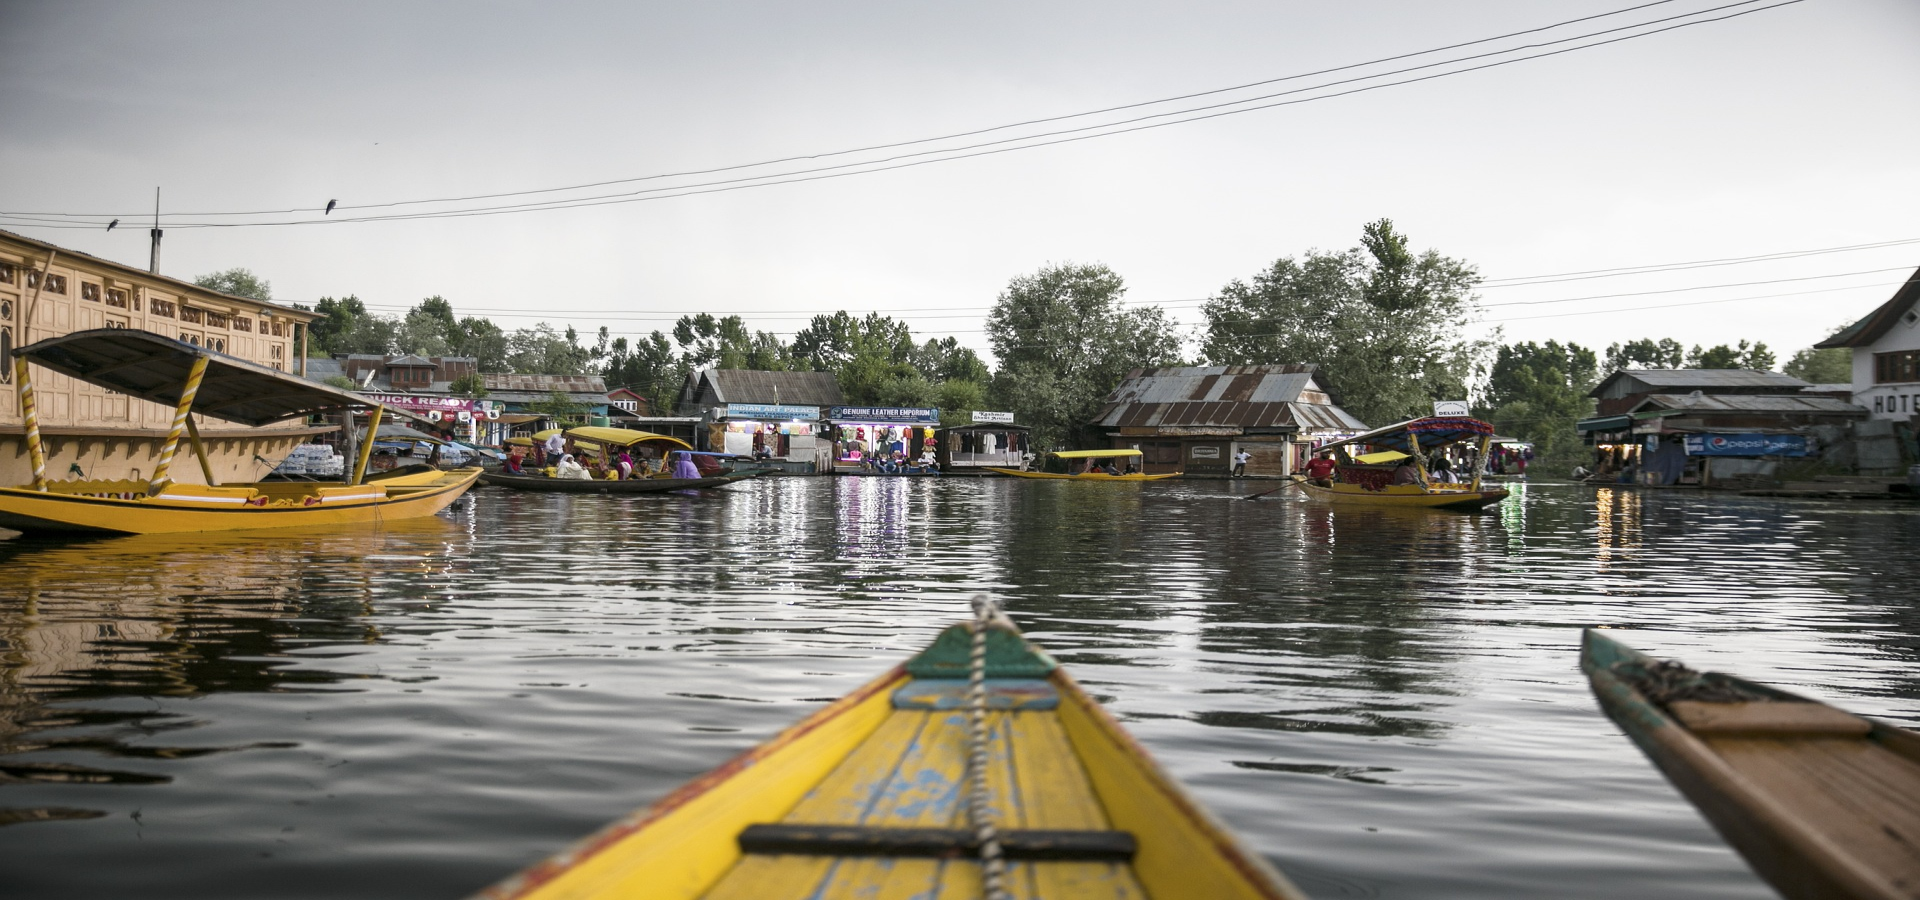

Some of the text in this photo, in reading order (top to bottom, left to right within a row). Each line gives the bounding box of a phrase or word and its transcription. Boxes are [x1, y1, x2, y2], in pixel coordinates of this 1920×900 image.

[418, 397, 471, 407] READY
[872, 408, 899, 416] LEATHER
[1727, 439, 1763, 449] pepsi
